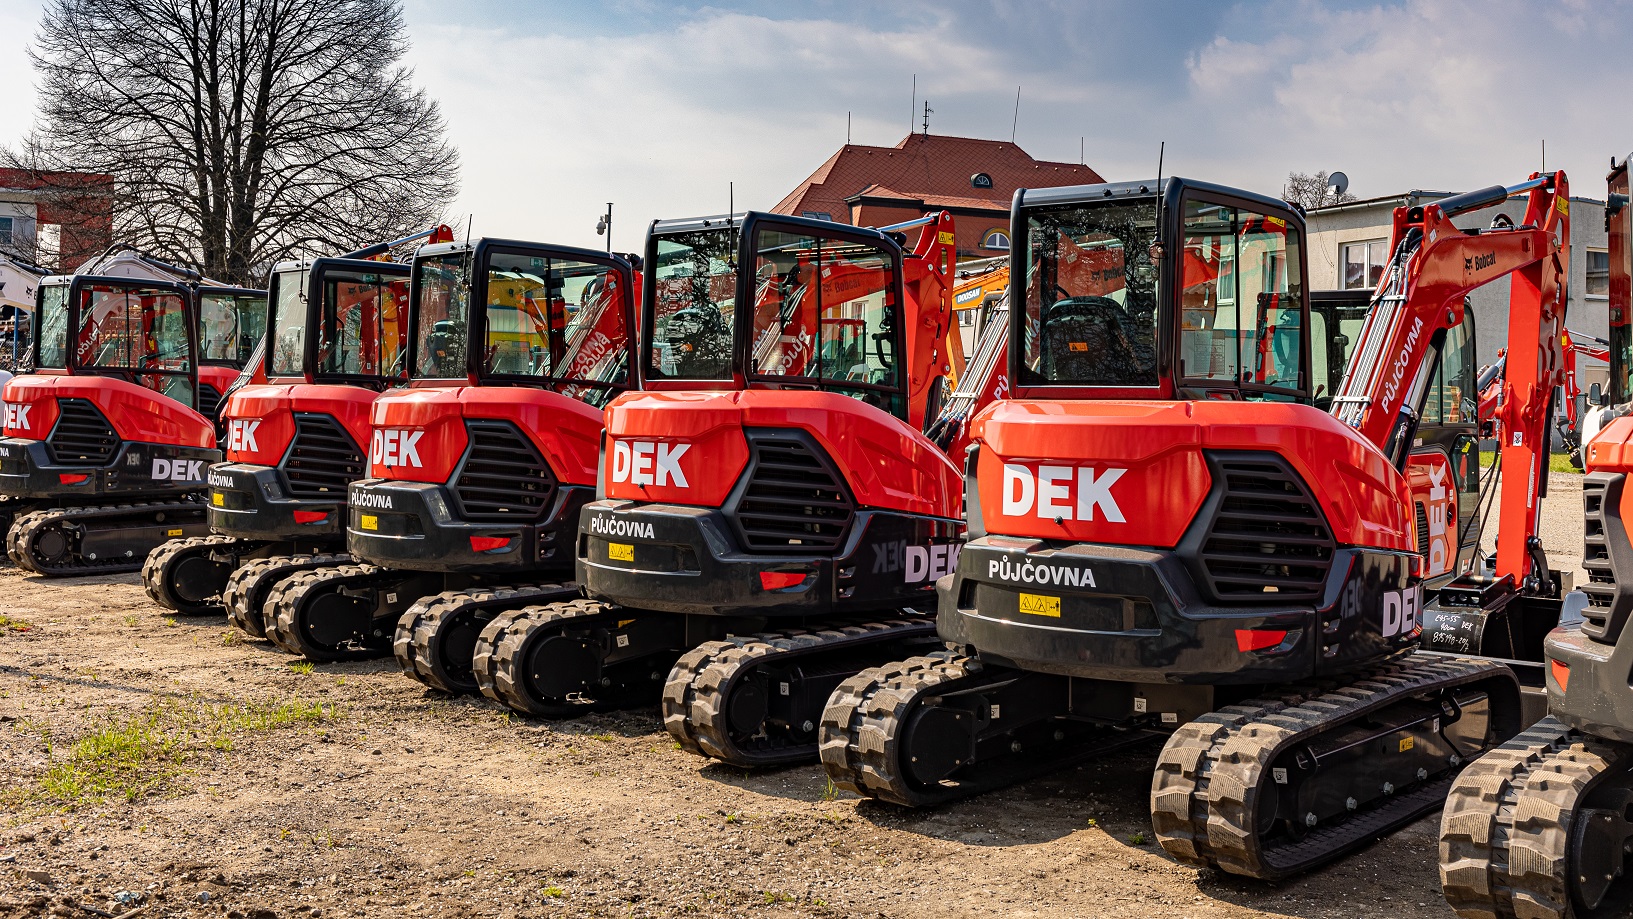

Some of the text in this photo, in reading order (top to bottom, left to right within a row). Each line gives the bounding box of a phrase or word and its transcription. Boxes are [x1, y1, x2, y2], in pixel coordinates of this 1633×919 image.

[1474, 250, 1496, 271] Bobcat
[957, 287, 981, 303] DOOSAN
[1381, 316, 1424, 415] PŮJČOVNA
[3, 403, 32, 430] DEK
[227, 420, 260, 452] DEK
[372, 429, 425, 468] DEK
[151, 458, 204, 481] DEK
[612, 440, 692, 488] DEK
[351, 488, 393, 509] PŮJČOVNA
[1002, 464, 1128, 524] DEK
[591, 513, 655, 539] PŮJČOVNA
[1429, 461, 1446, 576] DEK
[988, 554, 1097, 588] PŮJČOVNA
